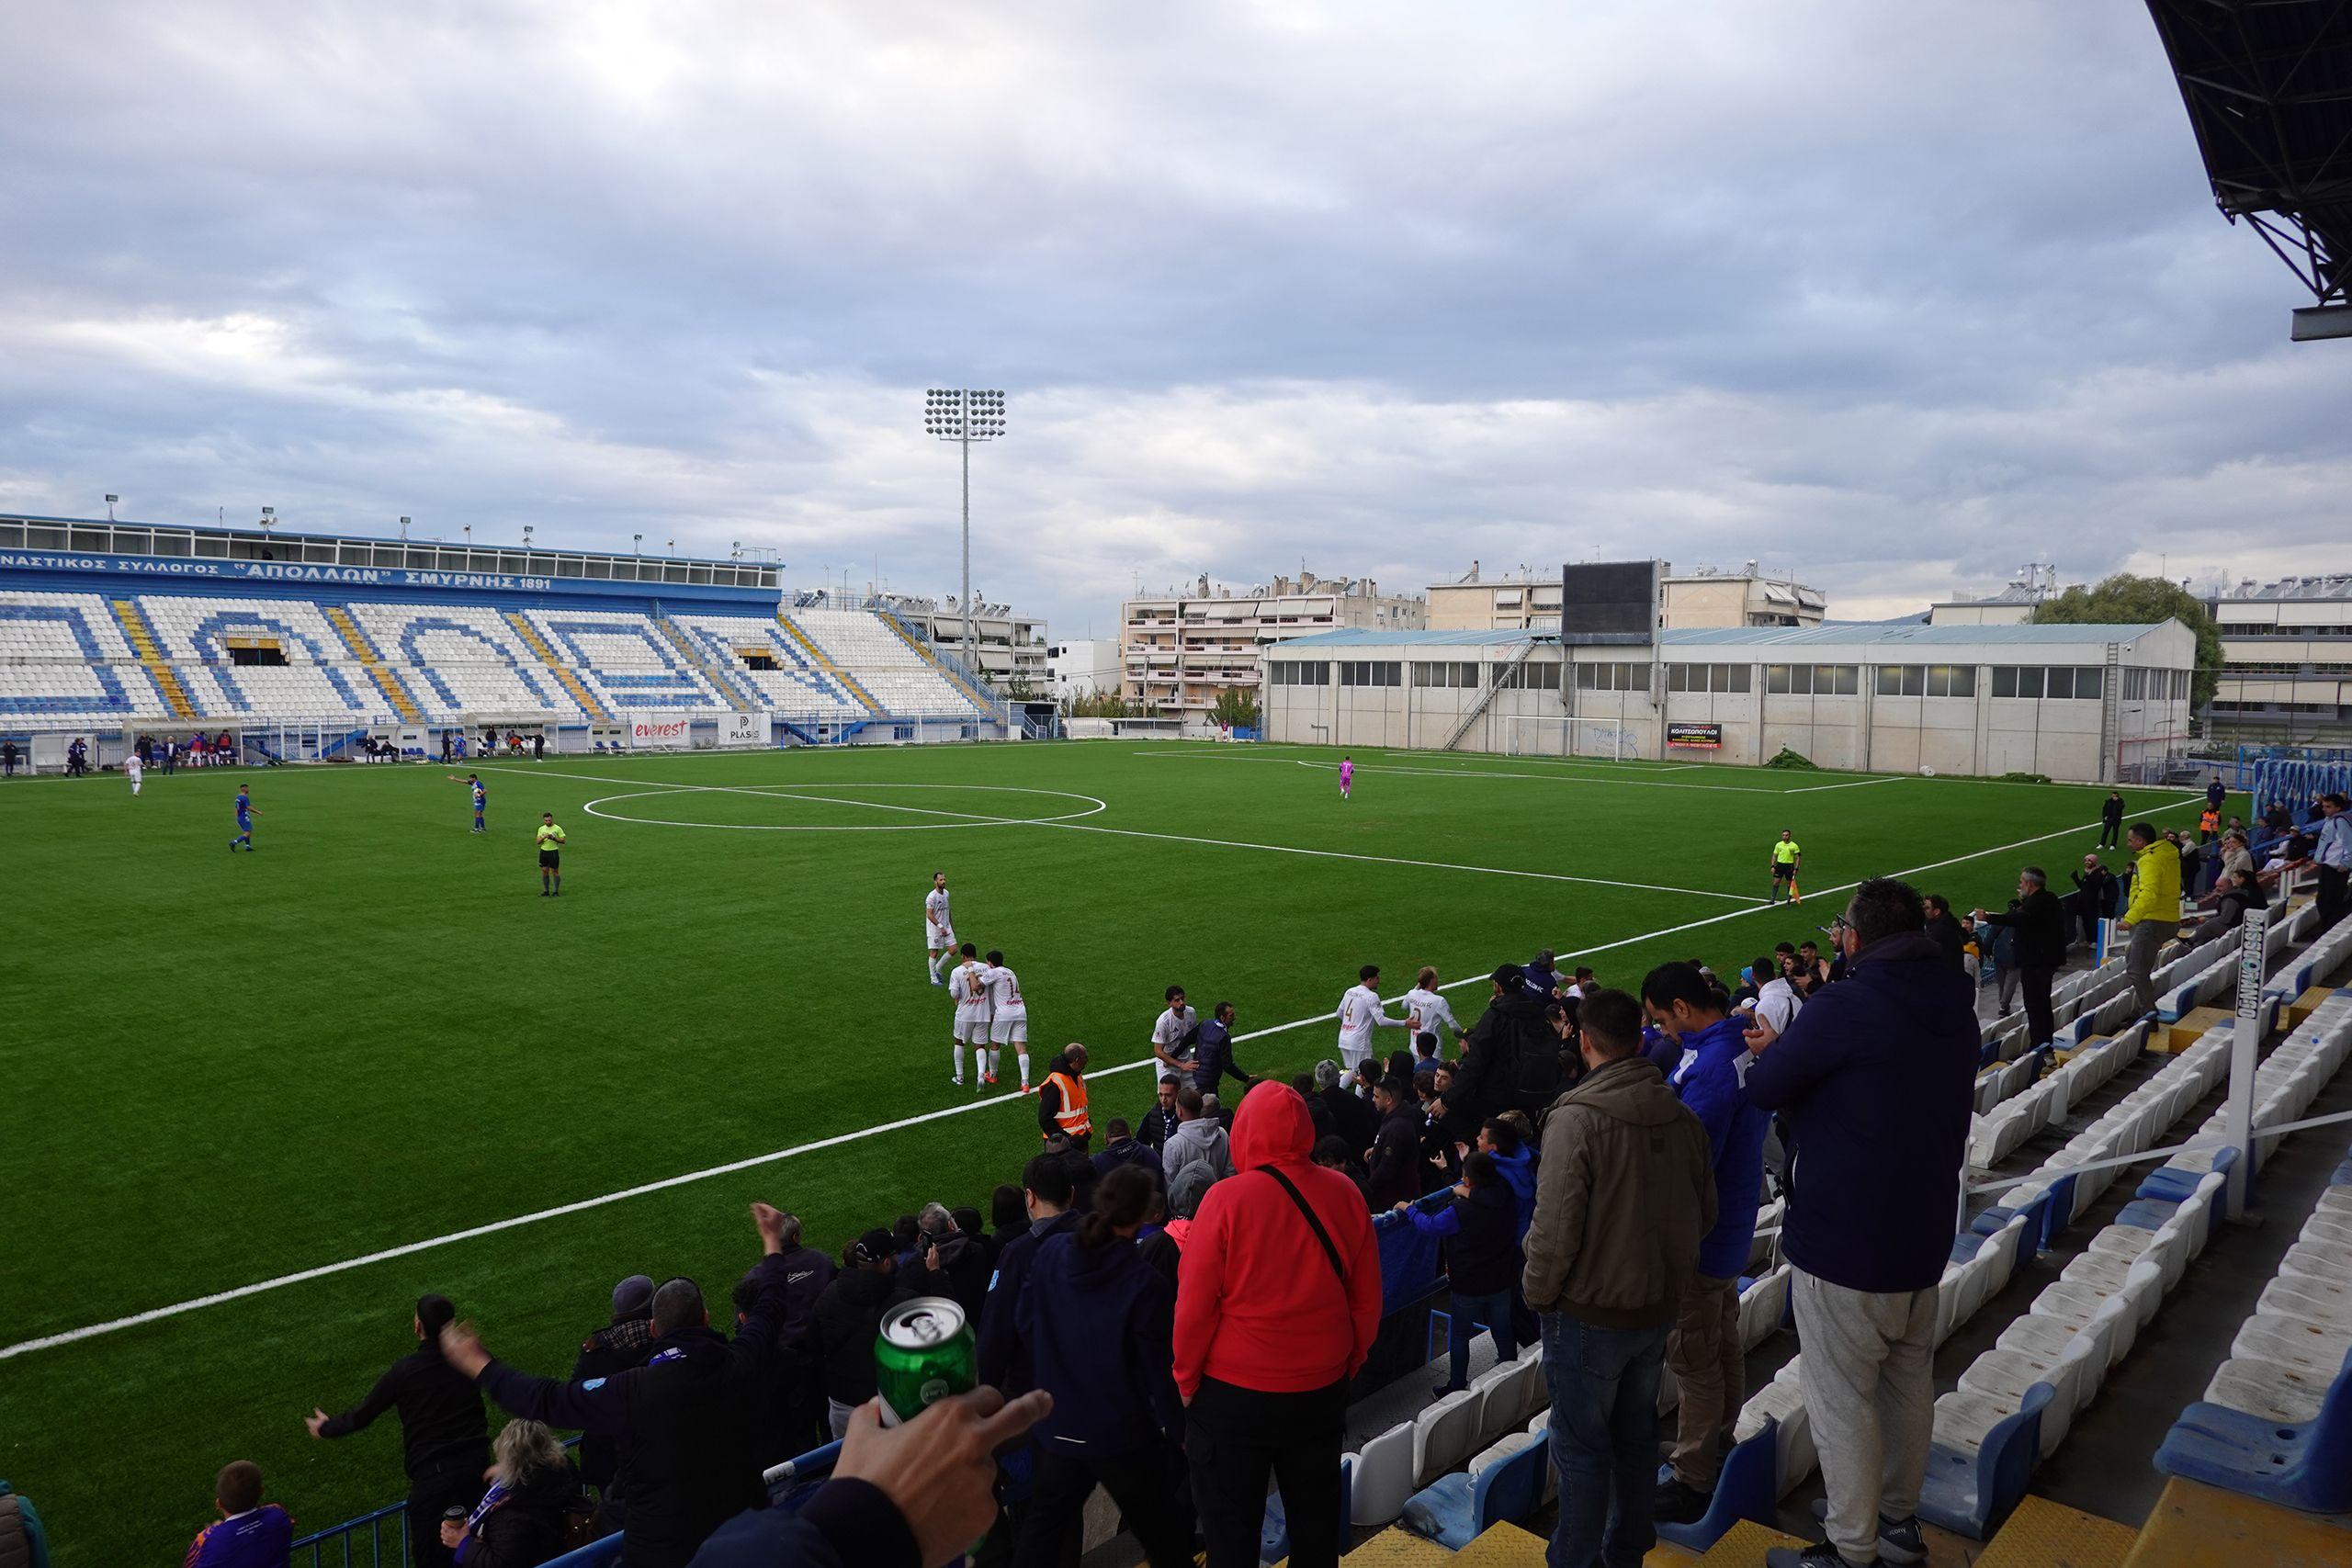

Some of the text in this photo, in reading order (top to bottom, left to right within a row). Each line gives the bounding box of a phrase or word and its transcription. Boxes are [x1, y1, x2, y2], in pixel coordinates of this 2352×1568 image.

[118, 560, 219, 574] ΣΥΛΛΟΓΟΣ
[404, 571, 514, 588] ΣΜΥΡΝΗΣ
[519, 577, 551, 590] 1891
[635, 719, 688, 737] everest
[1345, 998, 1353, 1021] 4
